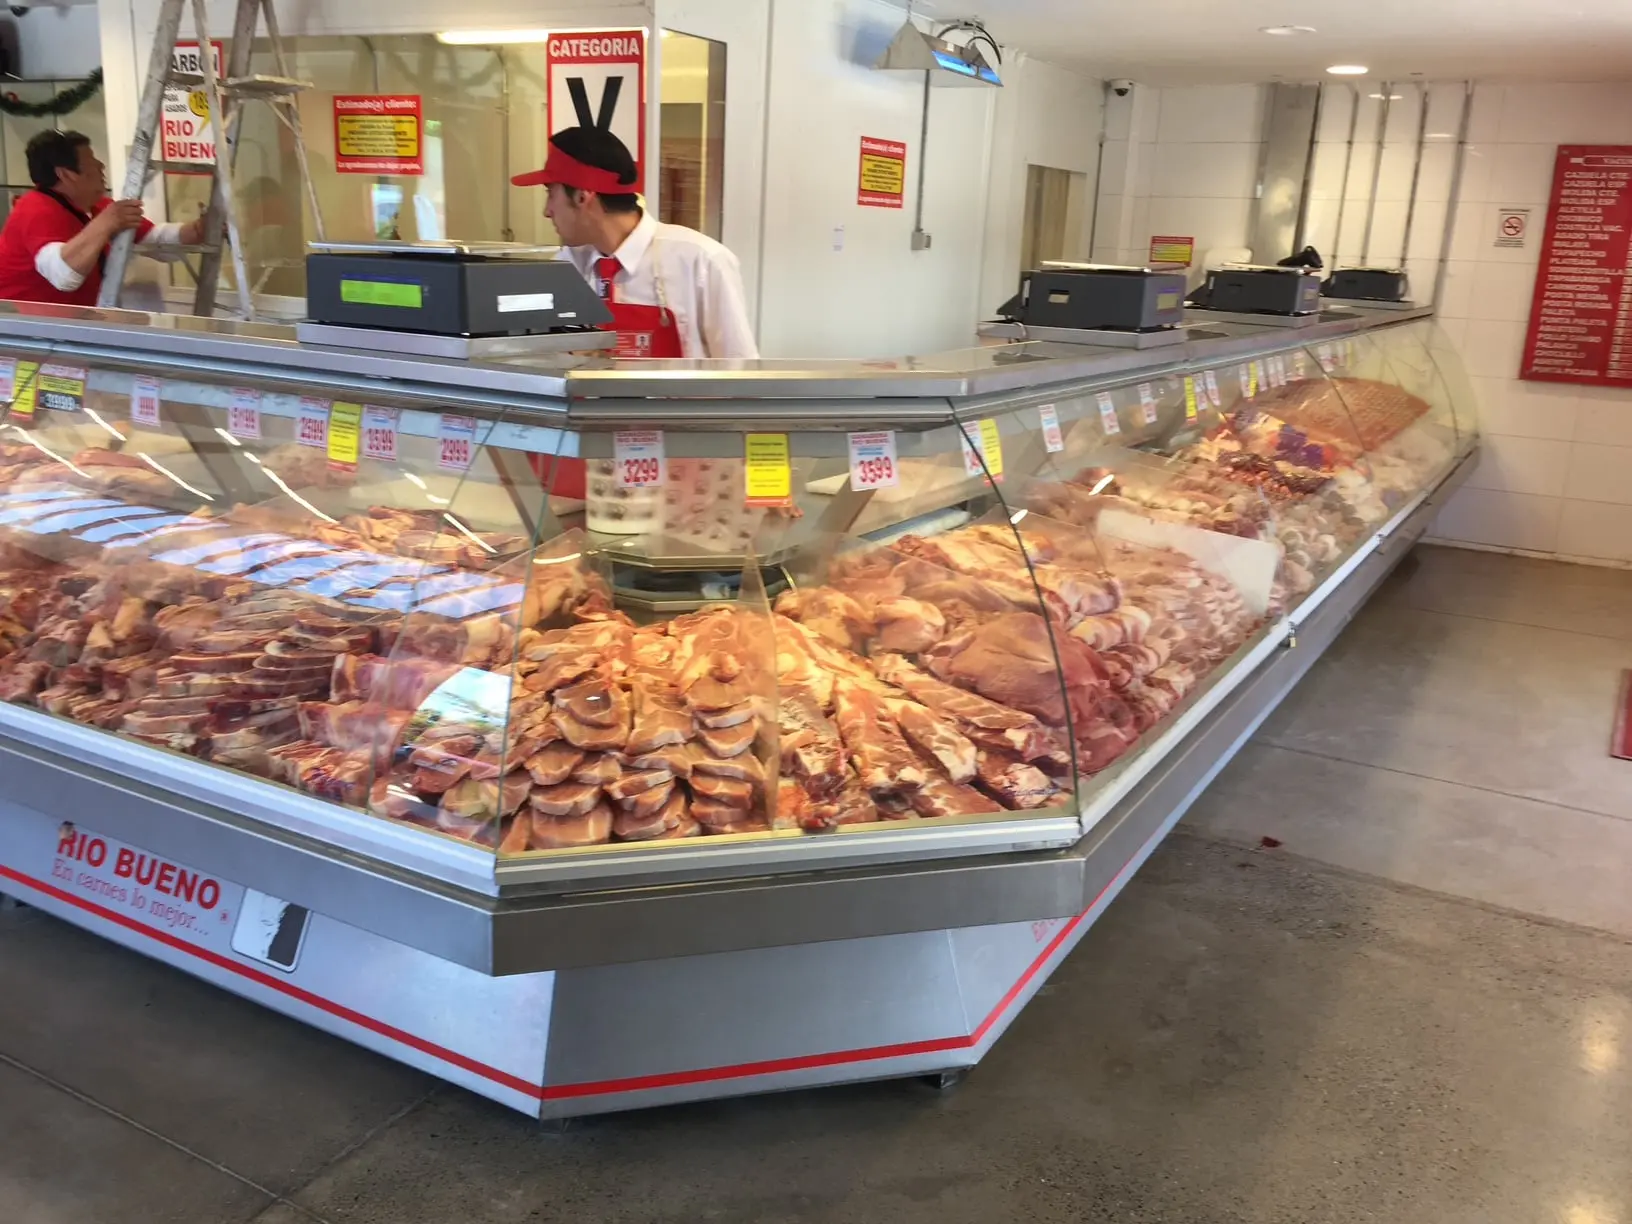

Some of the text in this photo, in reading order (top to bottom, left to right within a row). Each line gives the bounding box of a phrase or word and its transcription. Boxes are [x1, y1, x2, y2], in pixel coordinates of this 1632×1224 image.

[549, 38, 640, 57] CATEGORIA
[565, 76, 624, 132] V
[166, 120, 194, 136] RIO
[624, 458, 659, 483] 3299
[860, 456, 892, 483] 3599
[52, 858, 74, 882] En
[76, 872, 128, 902] carnes
[130, 887, 146, 909] lo
[114, 847, 221, 910] BUENO
